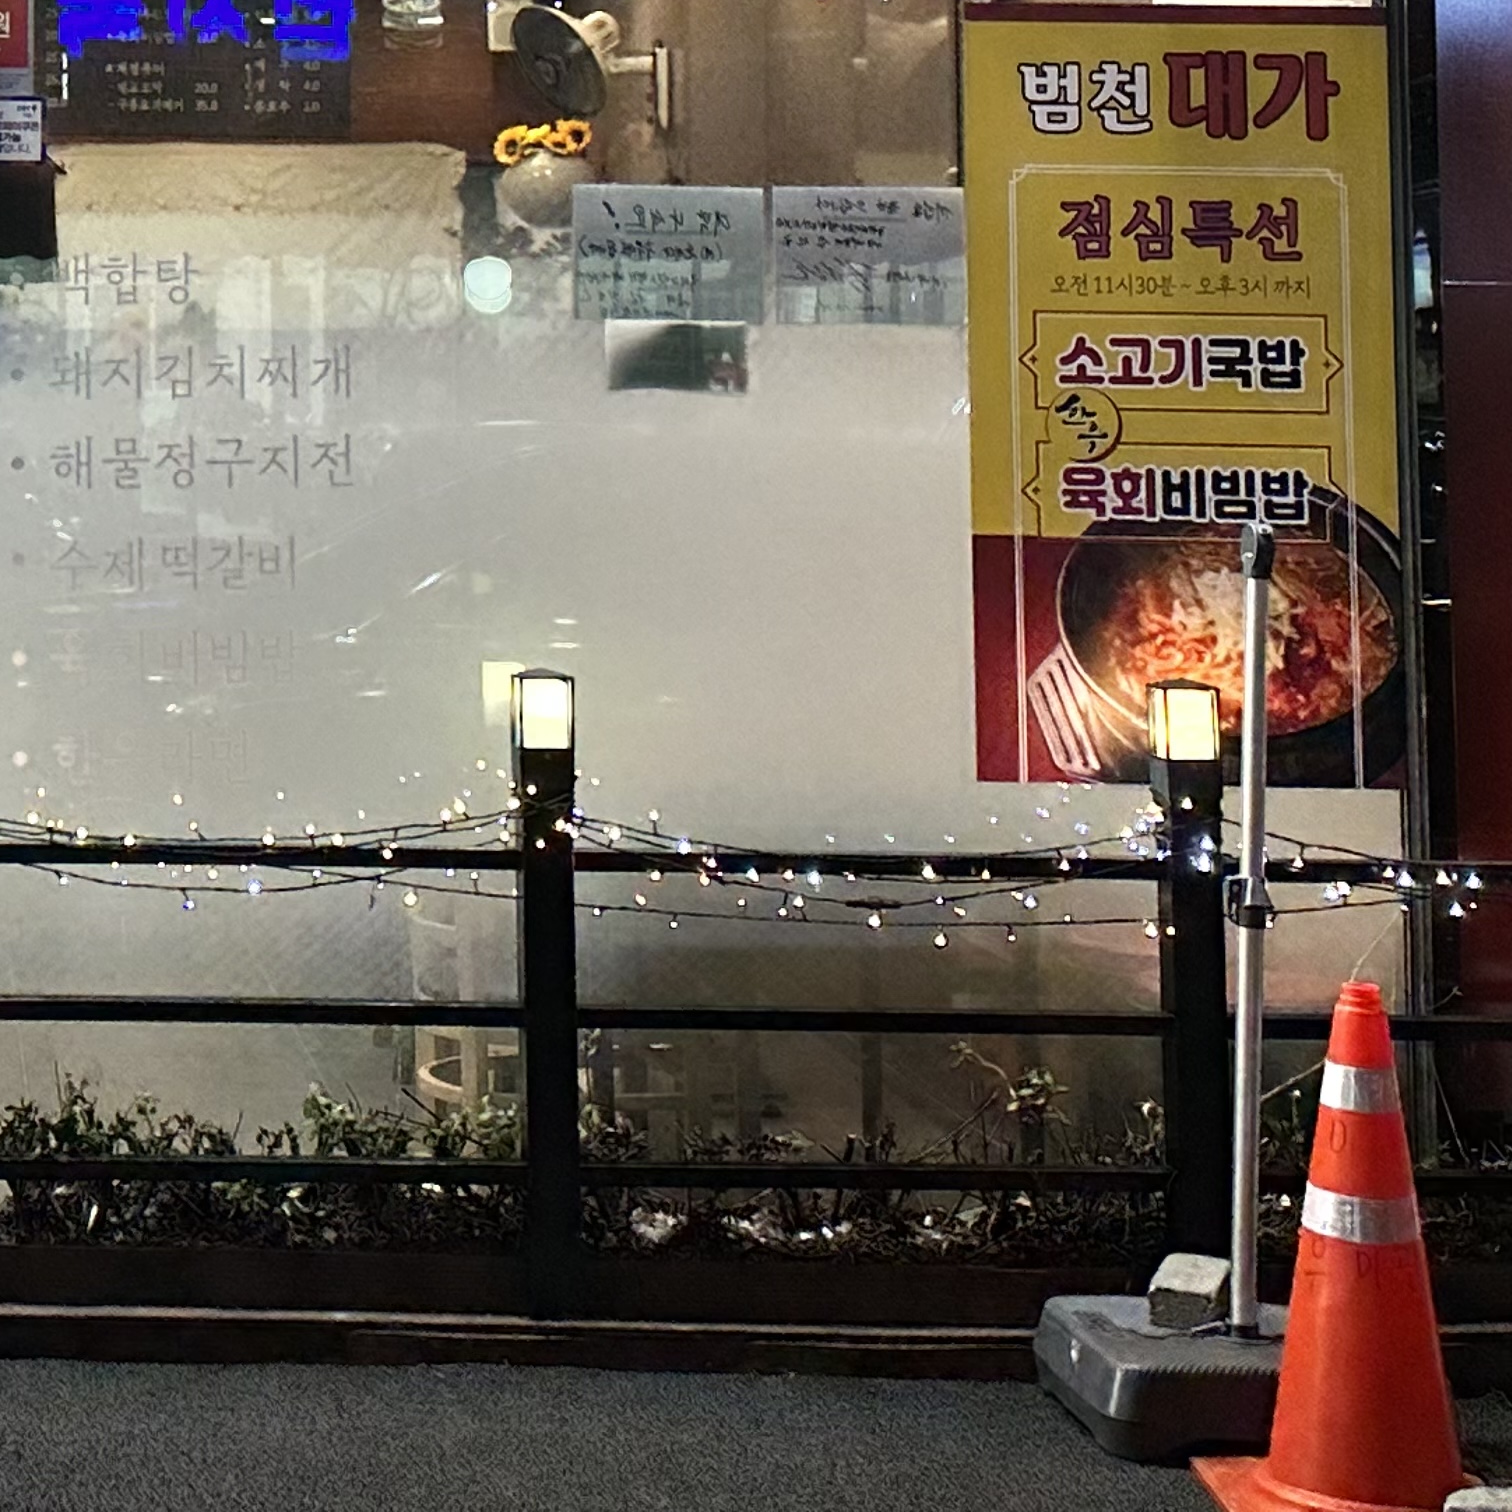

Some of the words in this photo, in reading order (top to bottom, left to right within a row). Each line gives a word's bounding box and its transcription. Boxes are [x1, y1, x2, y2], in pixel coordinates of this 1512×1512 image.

[1018, 60, 1153, 135] 범천
[1163, 50, 1340, 142] 대가
[1058, 194, 1303, 264] 점심특선
[49, 251, 200, 306] 백합탕
[1049, 275, 1090, 298] 오전
[1274, 275, 1312, 301] 까지
[48, 344, 353, 401] 돼지김치찌개
[1056, 335, 1308, 391] 소고기국밥
[48, 433, 354, 490] 해물정구지전
[1059, 464, 1312, 524] 육회비빔밥
